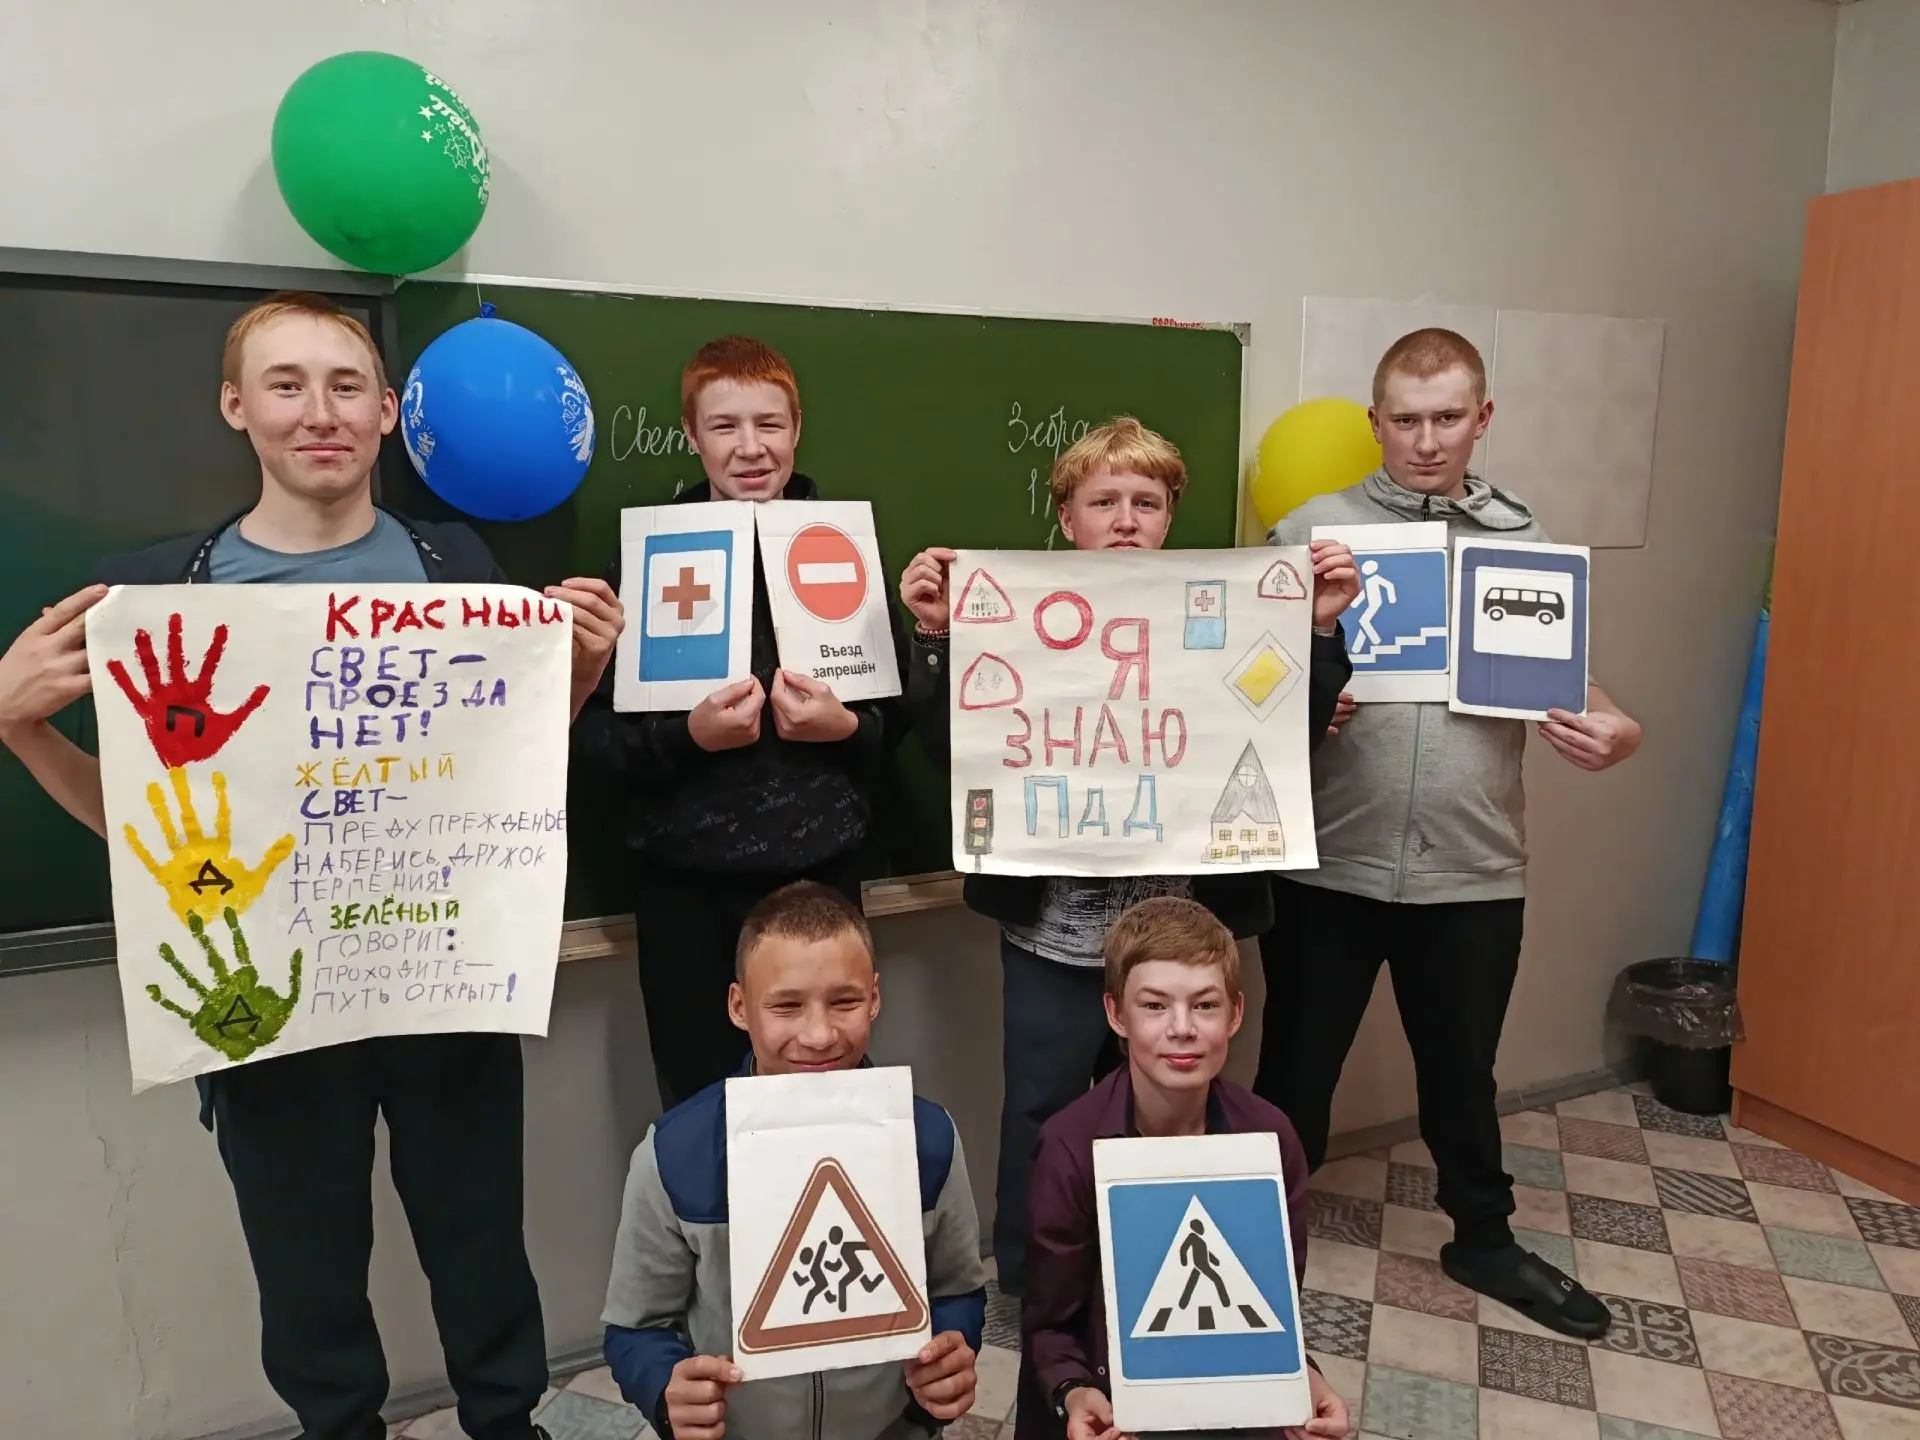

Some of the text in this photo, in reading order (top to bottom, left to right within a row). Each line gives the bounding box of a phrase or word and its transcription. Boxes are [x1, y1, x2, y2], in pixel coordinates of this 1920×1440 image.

[819, 644, 864, 658] Въезд
[1100, 617, 1150, 701] Я
[812, 660, 876, 680] запрещён
[166, 705, 206, 738] П
[311, 711, 432, 749] НЕТ!
[1002, 702, 1187, 769] ЗНАЮ
[295, 752, 456, 788] ЖЁЛТЫЙ
[1023, 774, 1163, 843] ПДД
[449, 841, 547, 870] ДРУЖОК
[189, 859, 234, 895] Д
[289, 865, 452, 904] ТЕРПЕНИЯ!
[288, 894, 459, 935] А ЗЕЛЁНЫЙ
[317, 927, 456, 962] ГОВОРИТ:
[311, 972, 517, 1014] ПУТЬ ОТКРЫТ!
